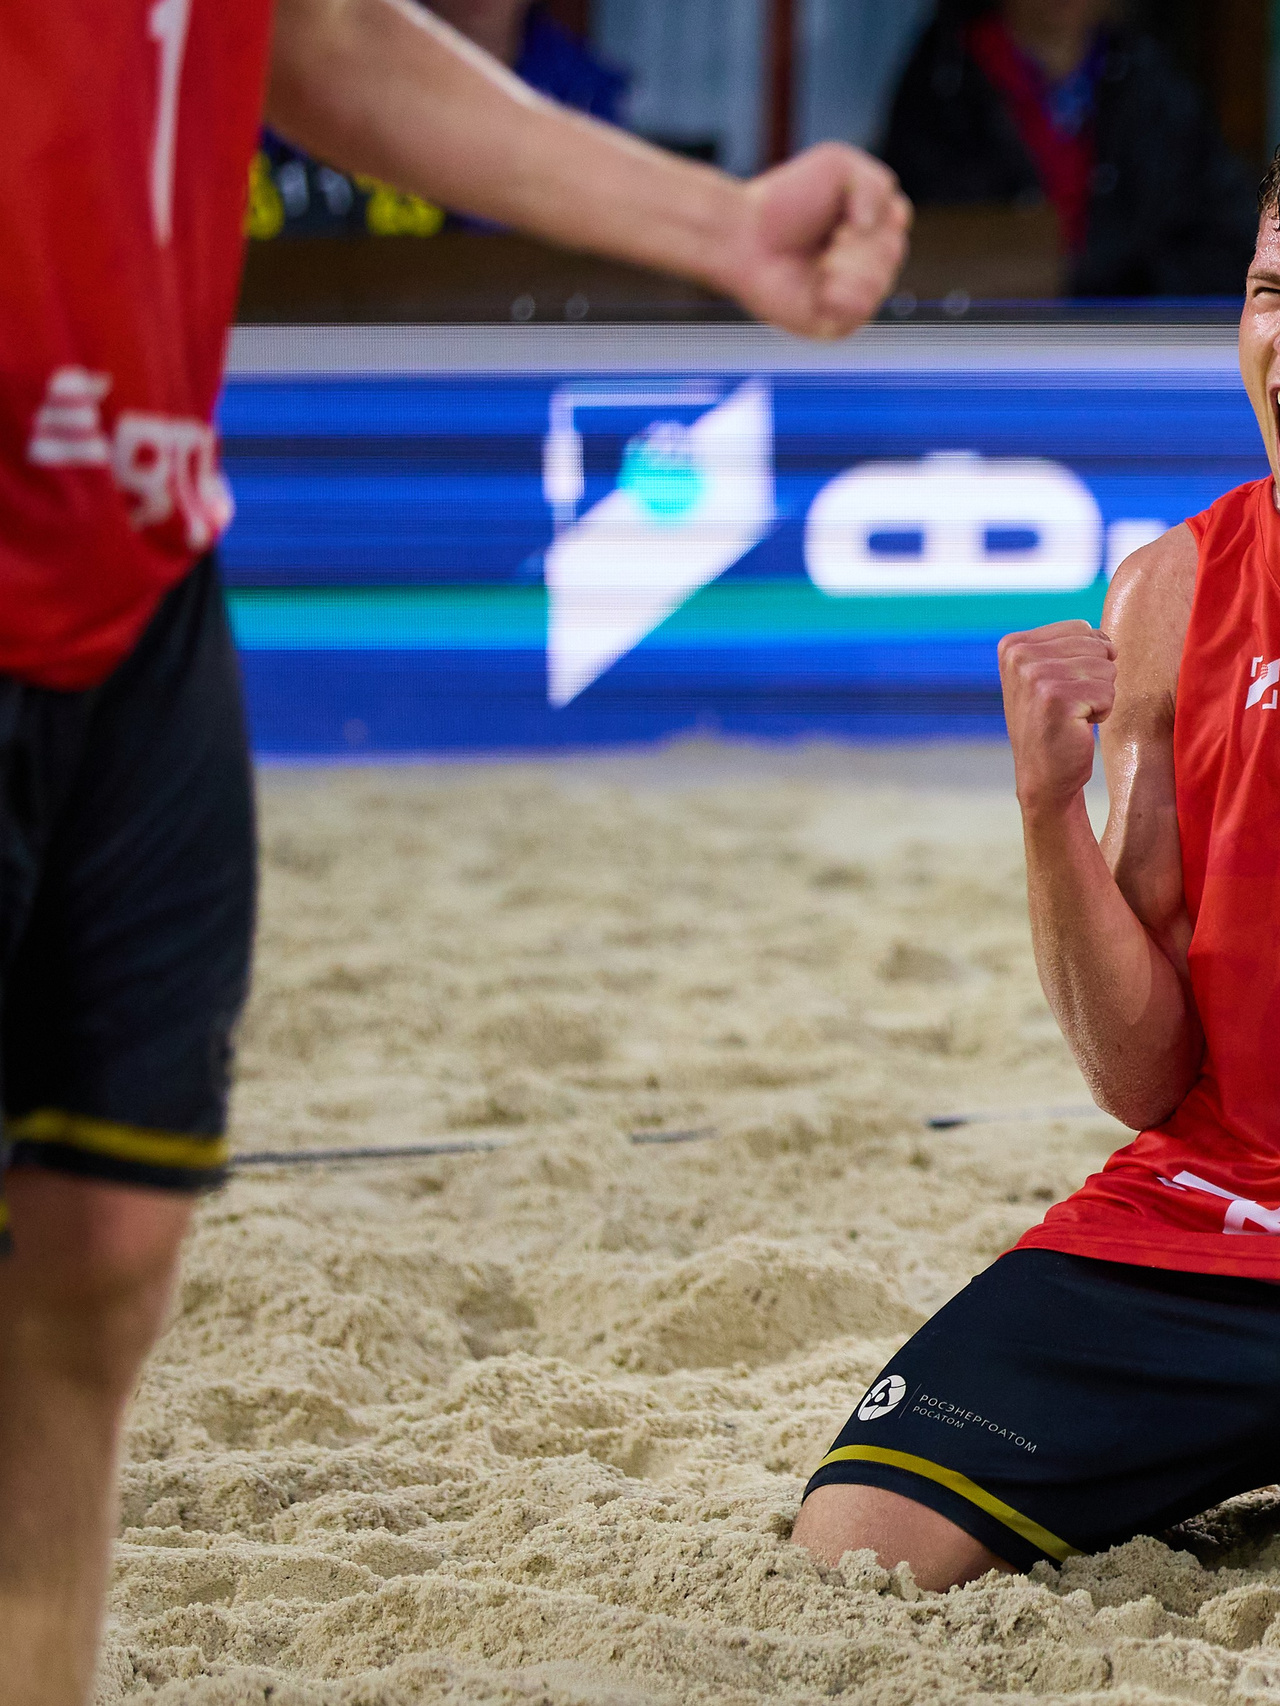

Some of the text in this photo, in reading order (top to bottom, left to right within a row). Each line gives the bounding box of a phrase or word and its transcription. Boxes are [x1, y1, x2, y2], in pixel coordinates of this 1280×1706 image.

[148, 0, 192, 248] 1
[912, 1405, 965, 1429] РОСАТОМ
[919, 1394, 1038, 1454] РОСЭНЕРГОАТОМ
